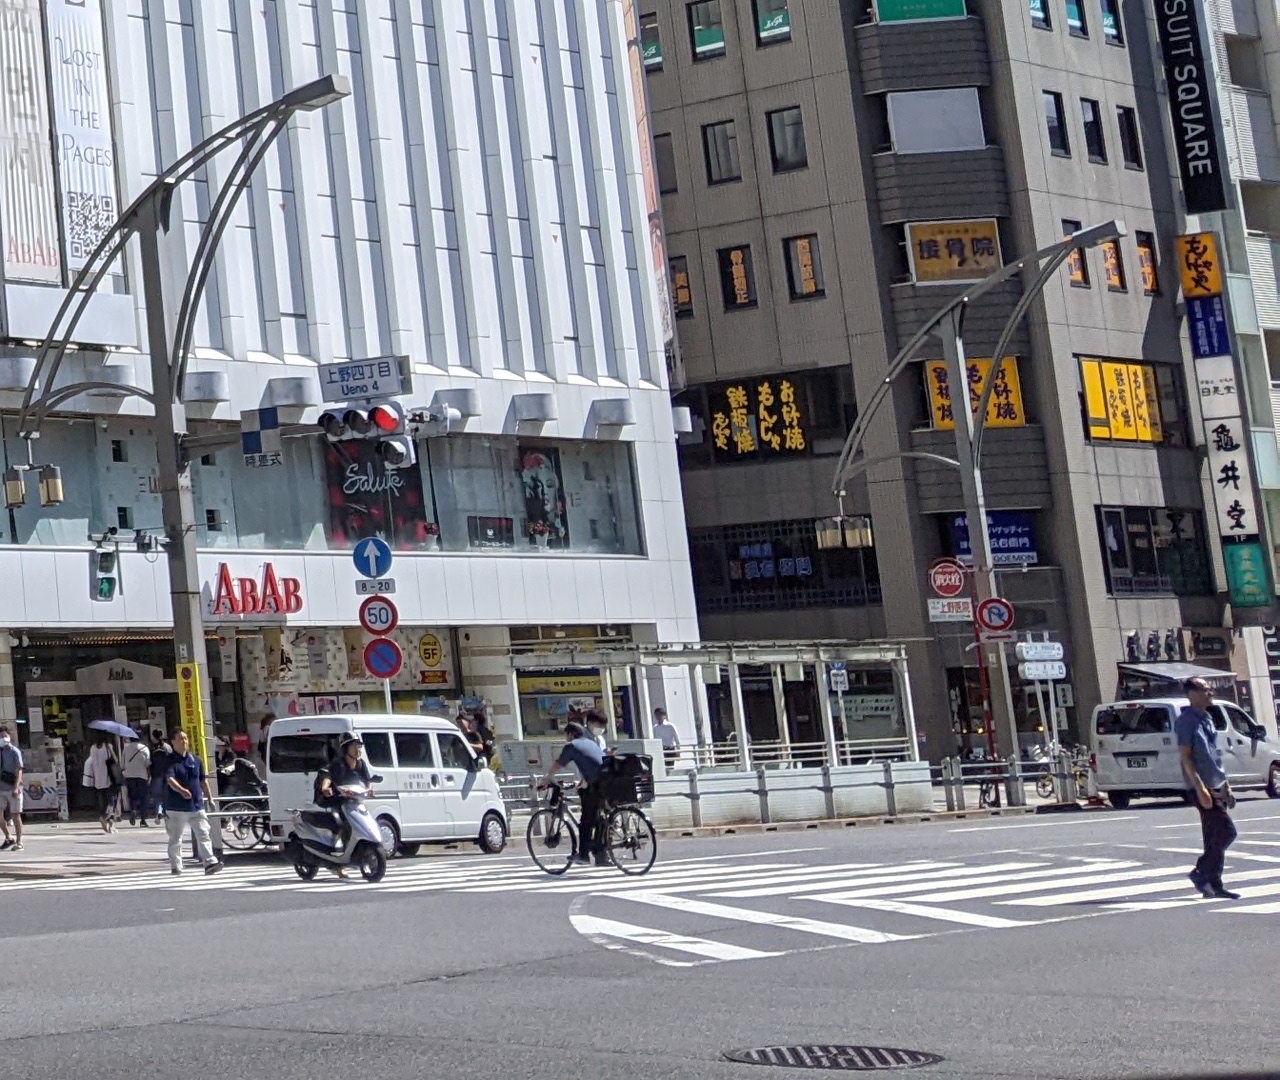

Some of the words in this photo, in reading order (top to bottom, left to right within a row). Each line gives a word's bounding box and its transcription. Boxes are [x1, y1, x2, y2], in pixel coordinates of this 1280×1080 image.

[70, 107, 100, 130] THE
[1174, 65, 1212, 178] SQUARE
[62, 133, 113, 168] PAGES
[6, 237, 58, 267] ABAB
[326, 361, 391, 385] 上野四丁目
[341, 385, 369, 396] Ueno
[372, 383, 380, 392] 4
[726, 385, 755, 454] 鉄板焼
[758, 382, 781, 452] もんじゃ
[781, 380, 805, 451] お好焼
[244, 452, 283, 468] 時差式
[343, 463, 404, 497] Salute
[1233, 535, 1247, 543] 1F
[214, 562, 303, 614] ABAB
[367, 607, 390, 625] 50
[423, 648, 438, 660] 5F
[108, 667, 133, 681] ABAB
